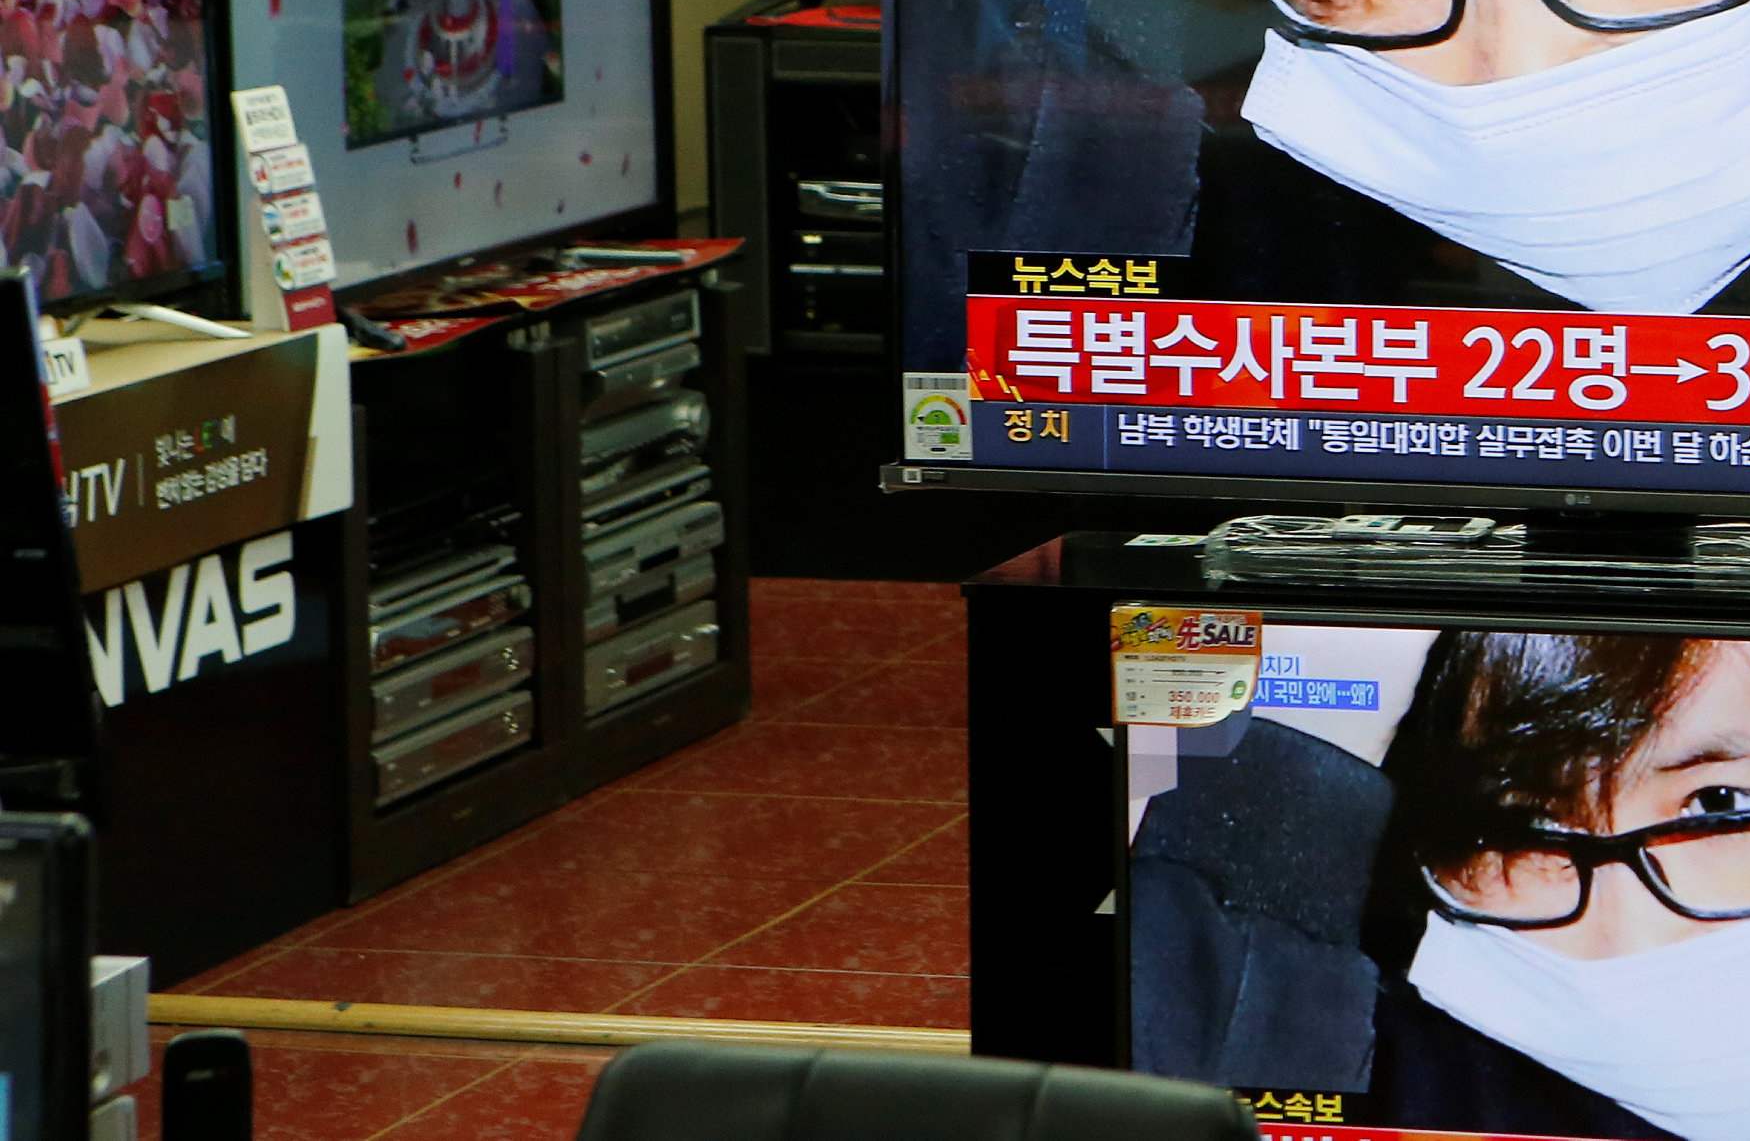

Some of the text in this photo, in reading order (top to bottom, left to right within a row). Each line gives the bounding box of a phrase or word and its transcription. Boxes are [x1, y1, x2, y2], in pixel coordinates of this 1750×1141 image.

[1011, 255, 1160, 295] 뉴스속보
[1008, 309, 1438, 403] 특별수사본부
[1117, 413, 1177, 446] 남북
[1182, 415, 1300, 451] 학생단체
[1475, 421, 1598, 460] 실무접촉
[1602, 427, 1664, 464] 이번
[1672, 430, 1704, 465] 달
[1259, 655, 1300, 677] 치기
[1273, 681, 1303, 705] 국민
